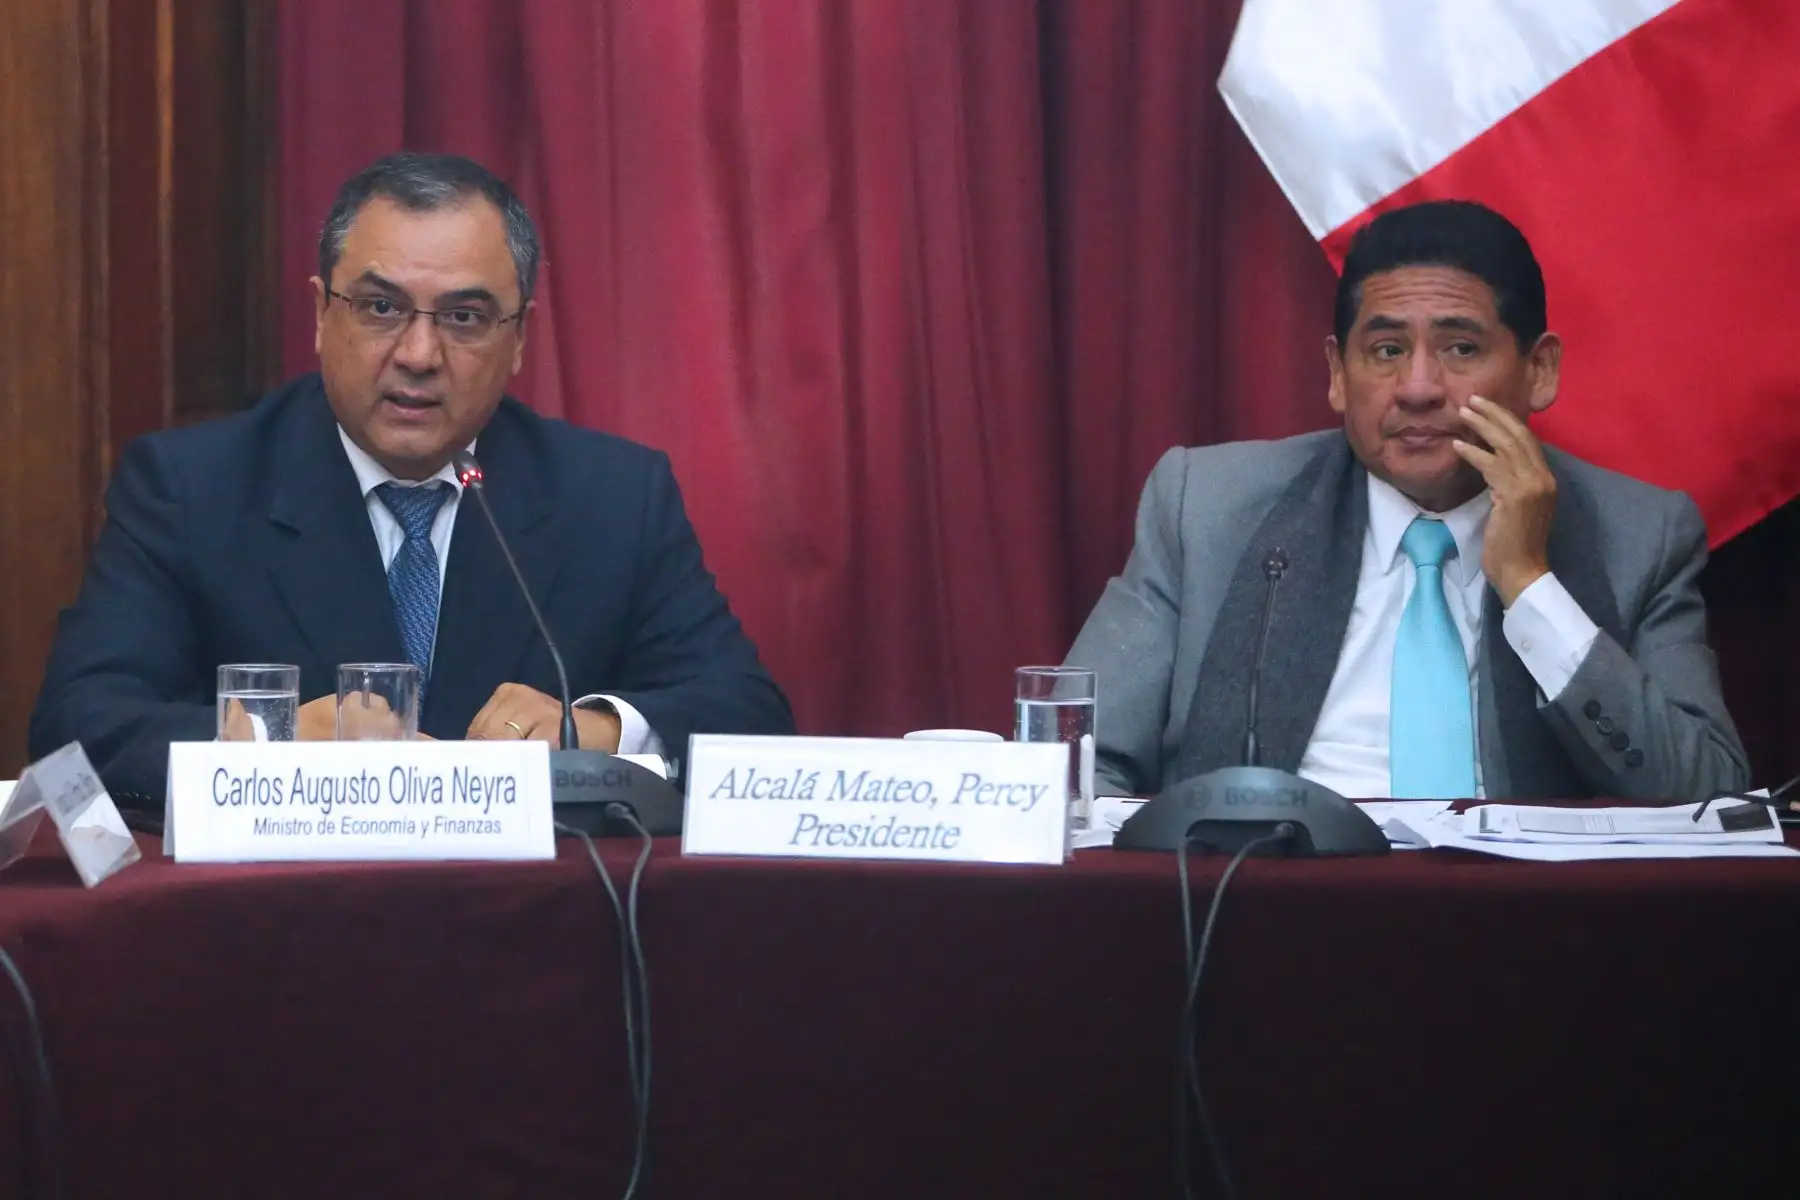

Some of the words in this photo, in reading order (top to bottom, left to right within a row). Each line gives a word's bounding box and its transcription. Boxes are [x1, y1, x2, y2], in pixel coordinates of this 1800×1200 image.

[212, 767, 284, 807] Carlos
[289, 767, 381, 816] Augusto
[388, 765, 443, 805] Oliva
[452, 766, 517, 815] Neyra
[709, 767, 821, 801] Alcalá
[826, 770, 938, 808] Mateo,
[950, 773, 1050, 812] Percy
[253, 817, 312, 836] Ministro
[317, 817, 335, 835] de
[420, 820, 429, 838] y
[434, 815, 502, 834] Finanzas
[789, 813, 962, 850] Presidente
